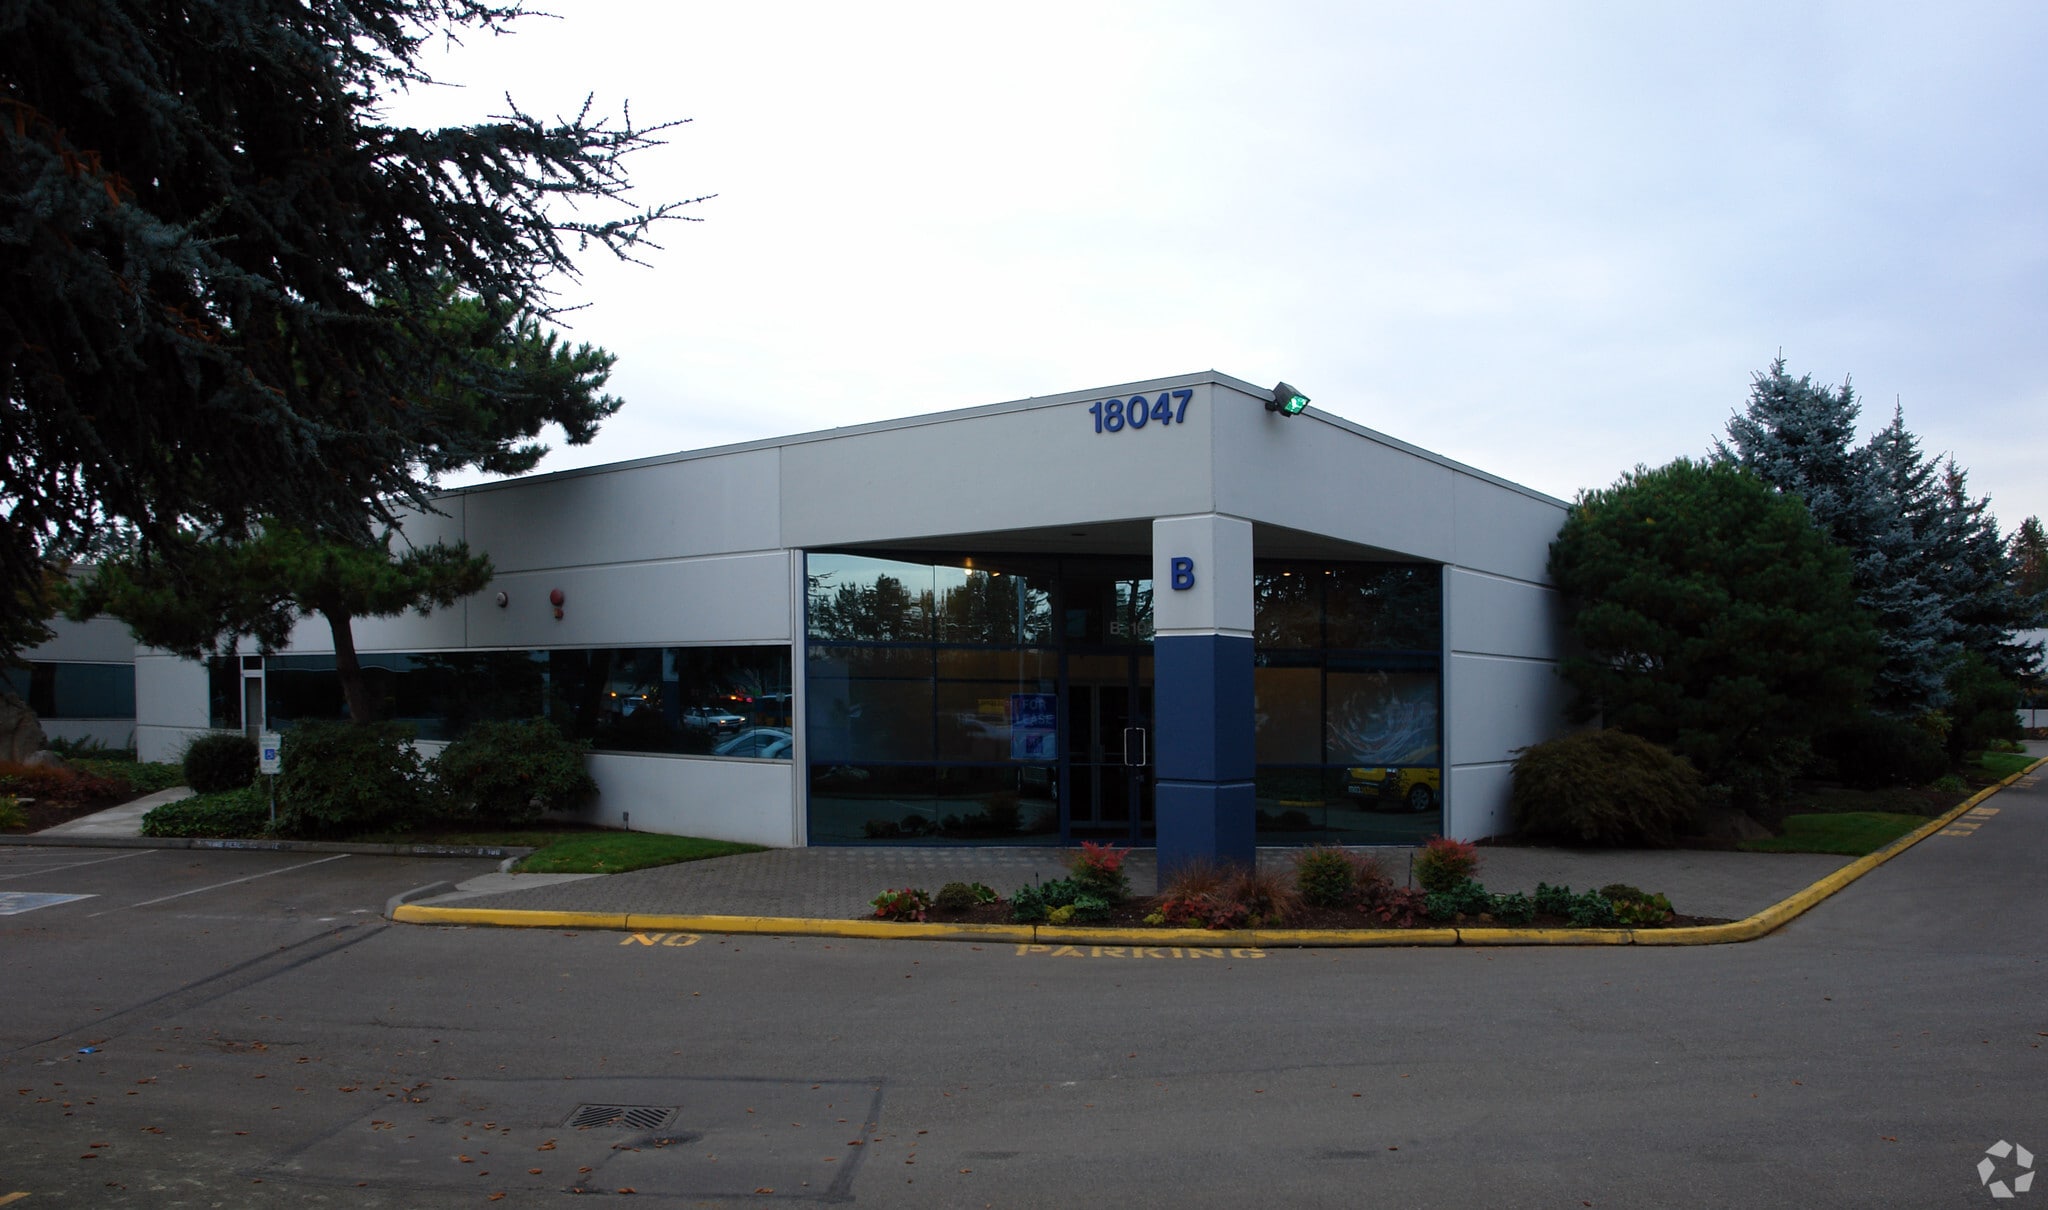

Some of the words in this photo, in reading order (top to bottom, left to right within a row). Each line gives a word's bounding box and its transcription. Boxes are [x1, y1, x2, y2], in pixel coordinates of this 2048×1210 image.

[1089, 388, 1193, 434] 18047
[1171, 556, 1195, 591] B
[1016, 714, 1054, 727] EASE
[619, 932, 703, 946] NO
[1015, 944, 1267, 959] PARKING
